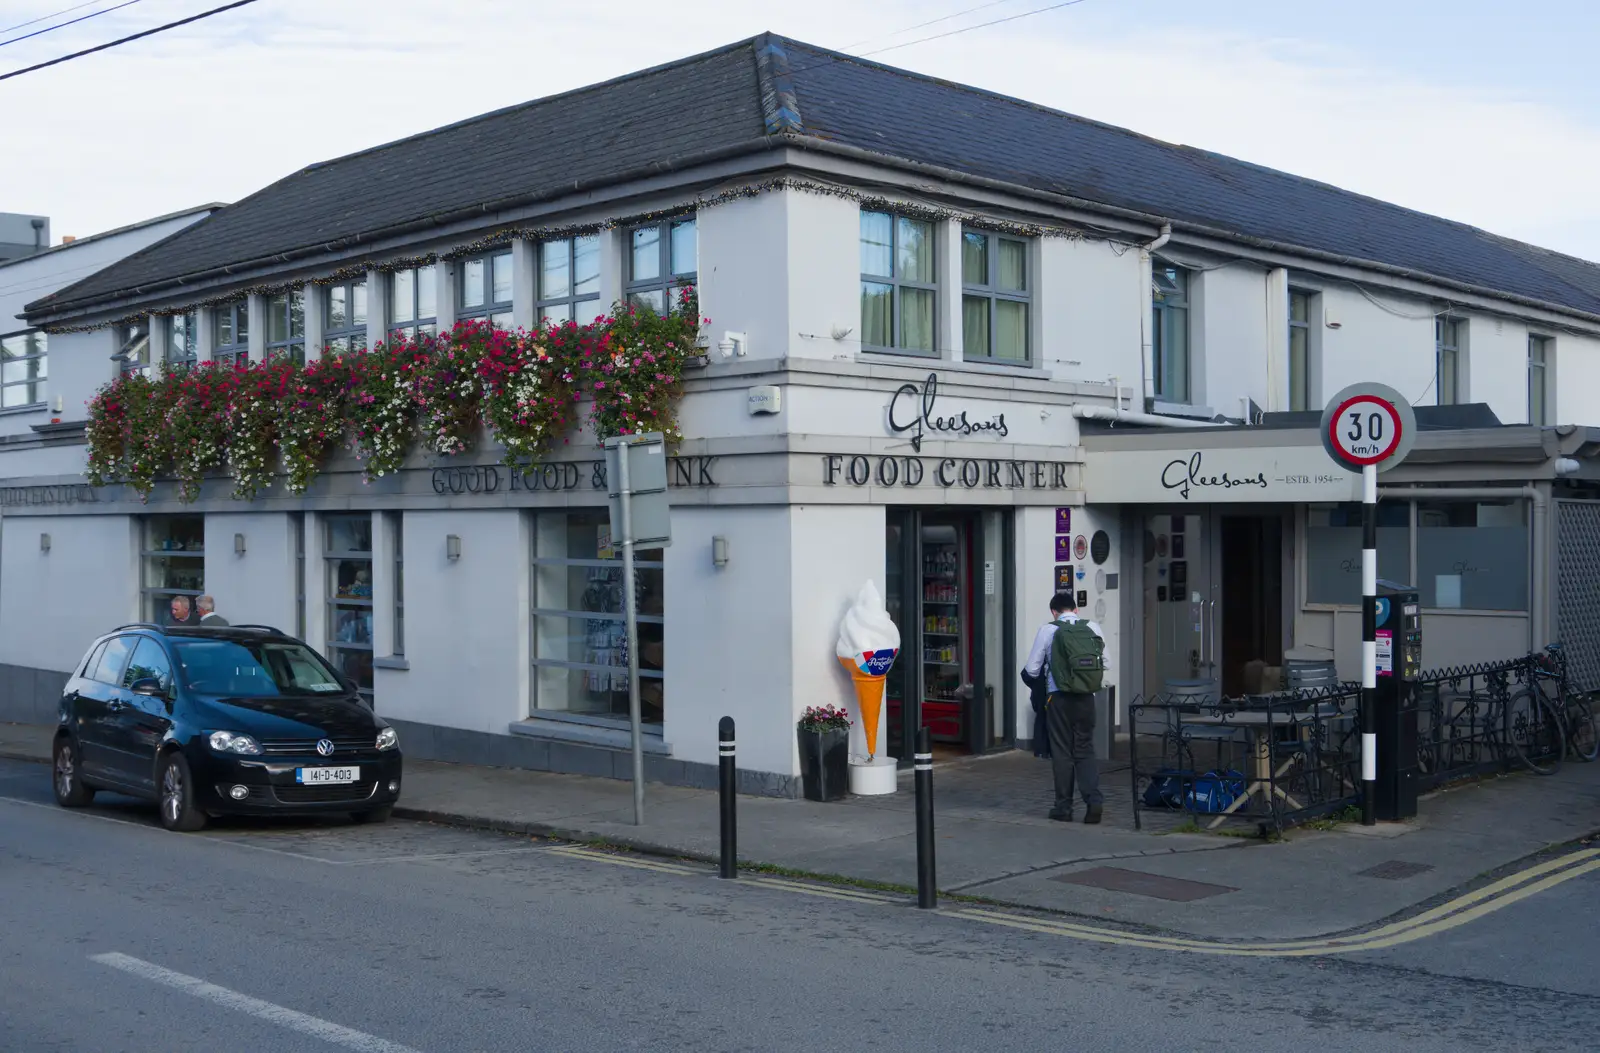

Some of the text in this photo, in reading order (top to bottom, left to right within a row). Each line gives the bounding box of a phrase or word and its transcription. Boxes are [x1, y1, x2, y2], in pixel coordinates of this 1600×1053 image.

[888, 372, 1009, 453] Gleesons
[1347, 412, 1383, 441] 30
[1351, 444, 1379, 454] km/h
[431, 461, 608, 494] GOOD FOOD &
[825, 454, 1069, 489] FOOD CORNER
[1160, 451, 1268, 500] Gleesons
[310, 769, 352, 781] 141-D-4013
